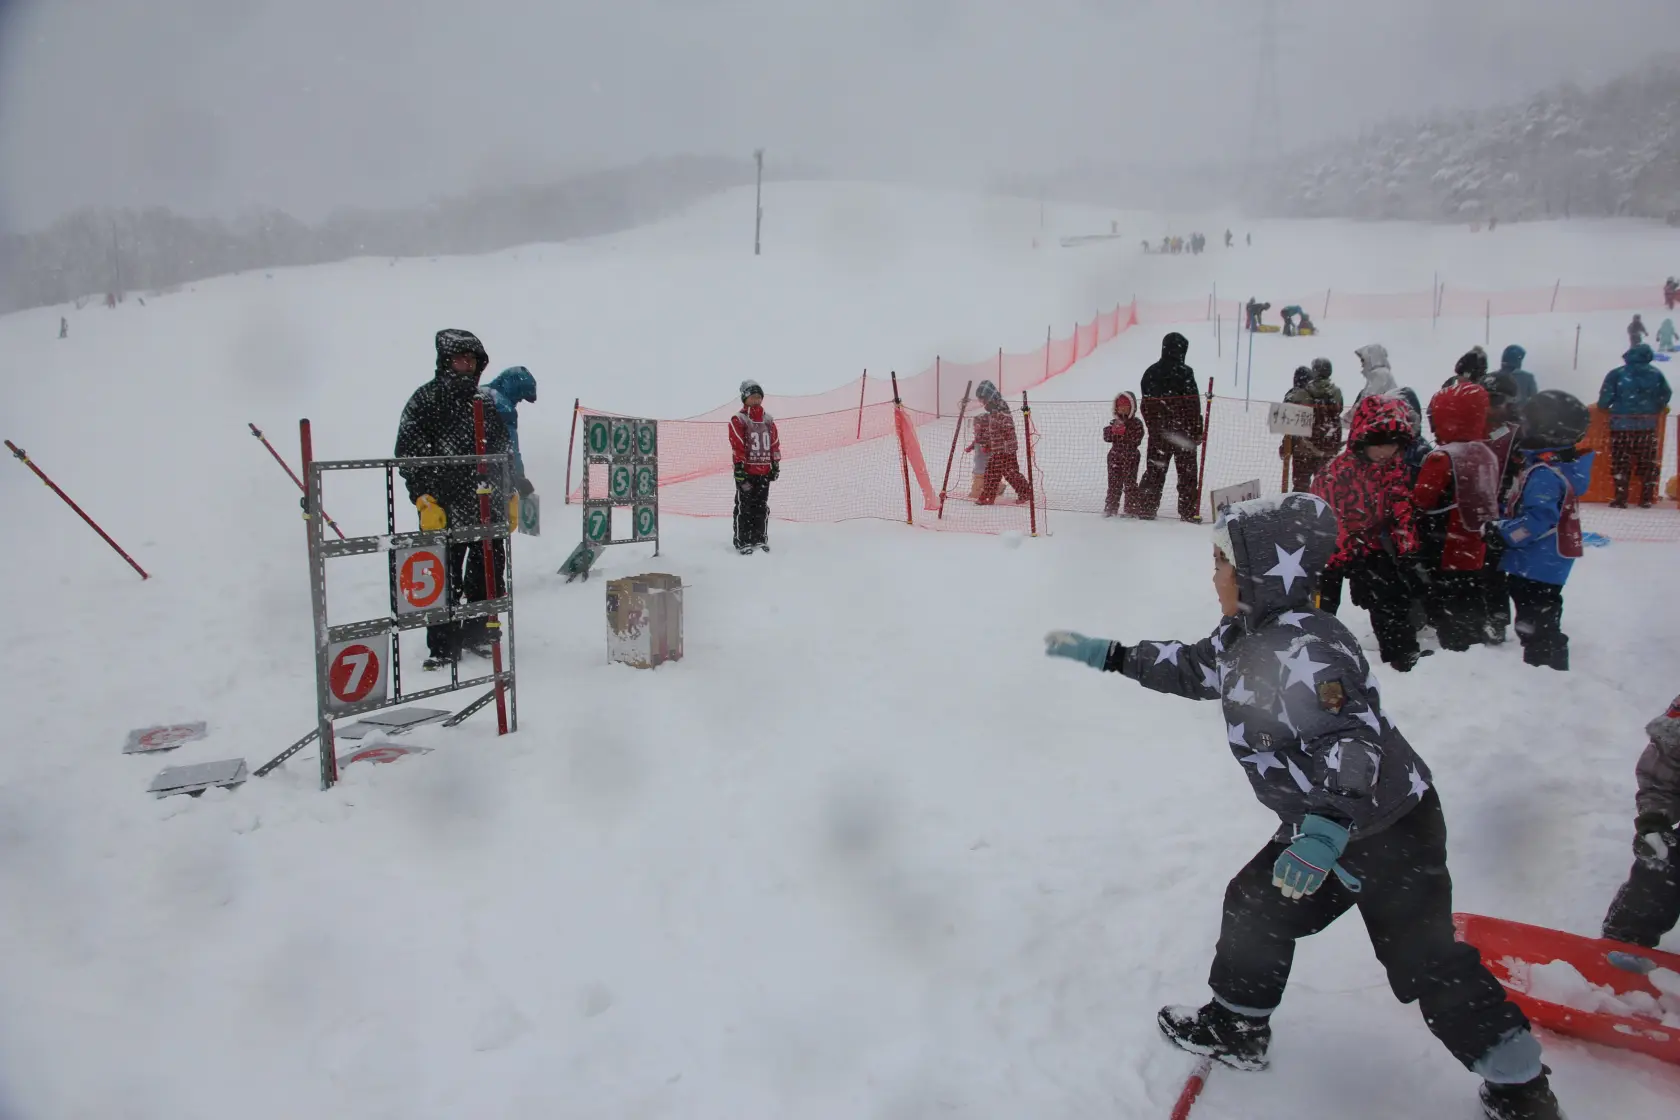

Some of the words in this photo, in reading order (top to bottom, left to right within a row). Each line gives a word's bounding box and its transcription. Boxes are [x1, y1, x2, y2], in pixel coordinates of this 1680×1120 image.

[616, 427, 627, 450] 2
[641, 428, 651, 449] 3
[750, 431, 770, 451] 30
[615, 472, 627, 493] 5
[639, 472, 651, 492] 8
[591, 515, 603, 537] 7
[640, 511, 651, 532] 9
[412, 559, 437, 599] 5
[342, 652, 370, 695] 7
